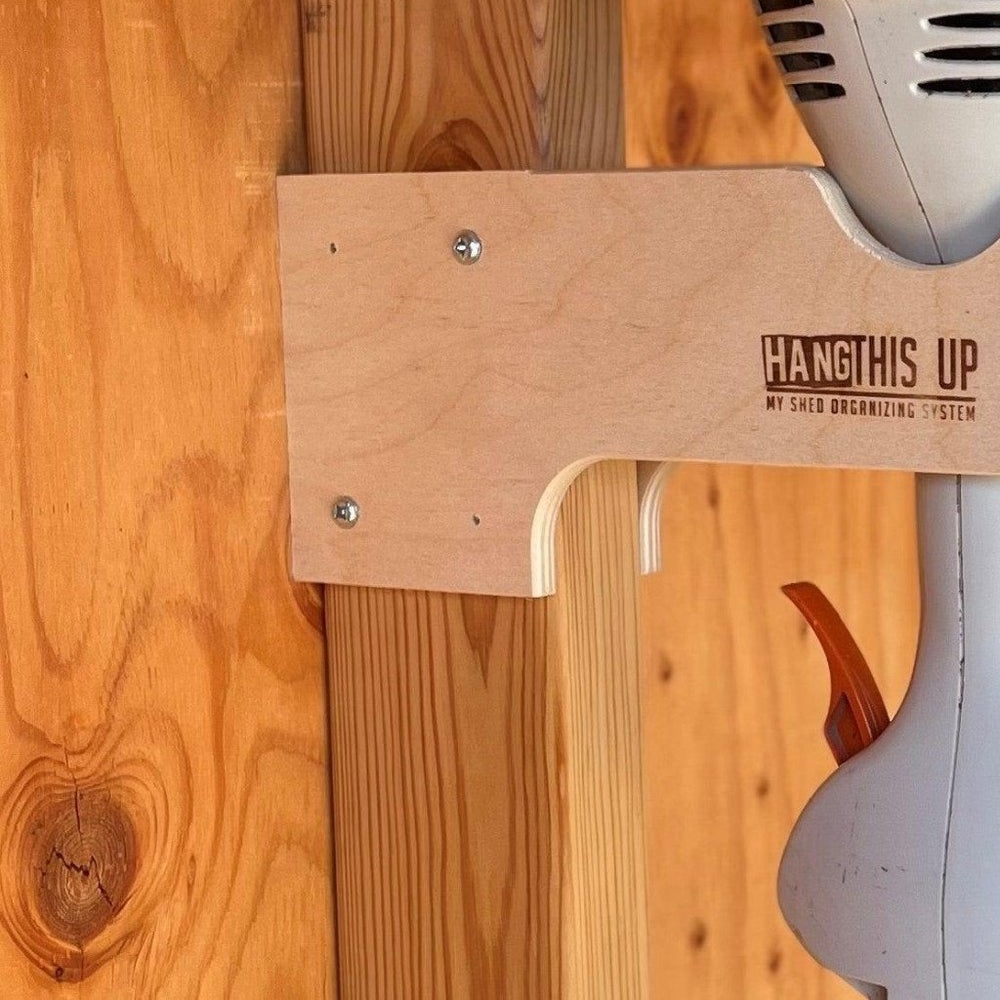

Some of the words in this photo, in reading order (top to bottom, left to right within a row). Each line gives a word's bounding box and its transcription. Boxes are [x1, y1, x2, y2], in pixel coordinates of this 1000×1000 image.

[938, 337, 978, 391] UP
[766, 395, 783, 411] MY
[790, 397, 824, 414] SHED
[830, 398, 915, 419] ORGANIZING
[922, 402, 976, 422] SYSTEM
